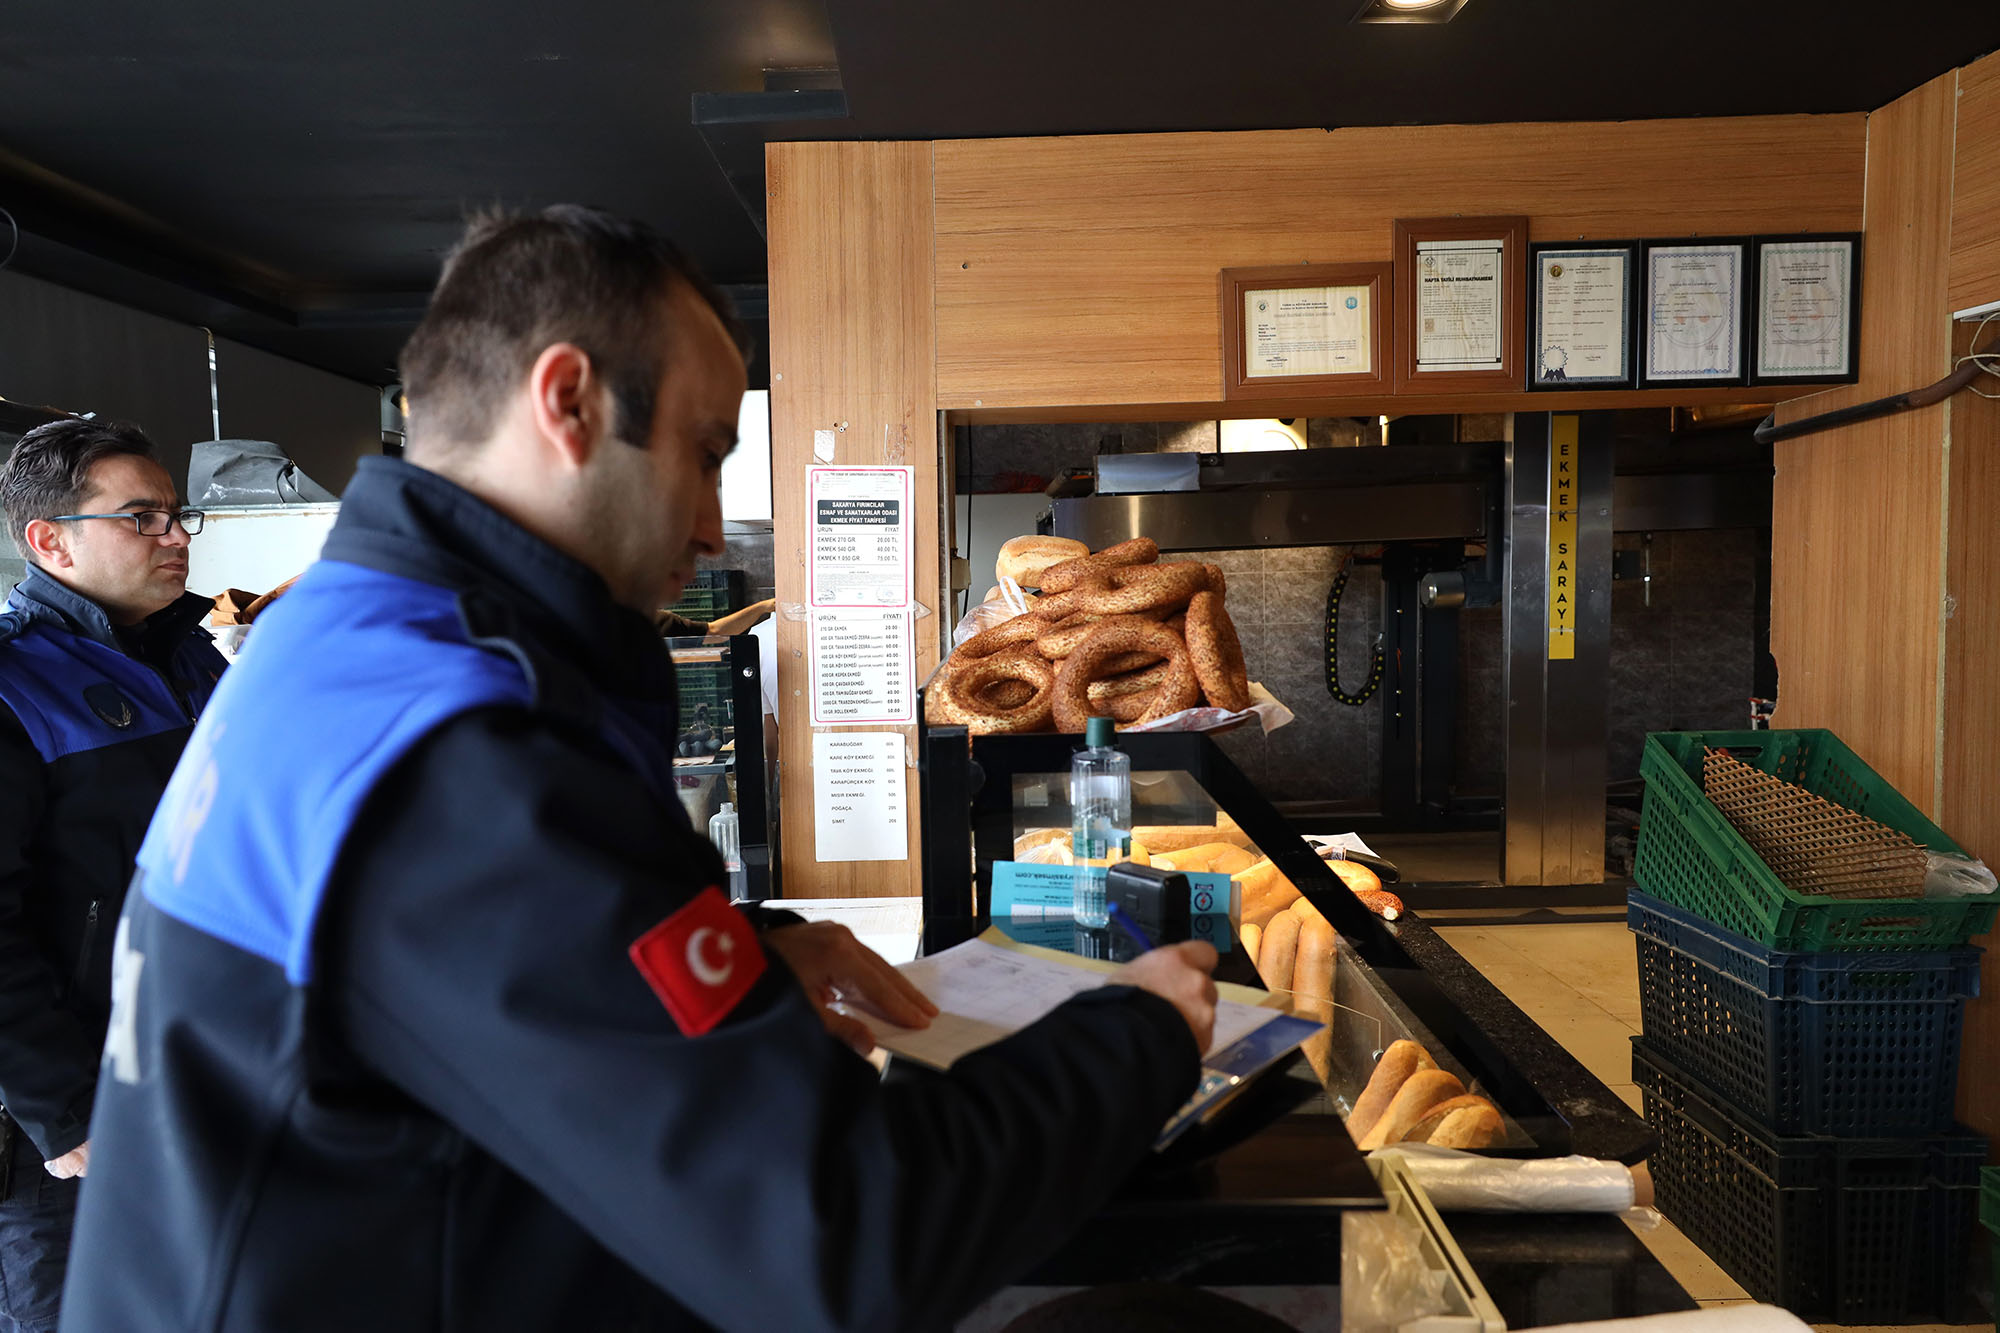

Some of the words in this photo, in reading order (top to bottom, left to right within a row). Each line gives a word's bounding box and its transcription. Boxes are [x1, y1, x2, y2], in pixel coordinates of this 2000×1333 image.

[1558, 443, 1571, 522] EKMEK
[849, 516, 863, 524] FİYAT
[863, 516, 887, 524] TARİFESİ
[856, 501, 885, 509] FIRINCILAR
[1556, 543, 1569, 636] SARAYI
